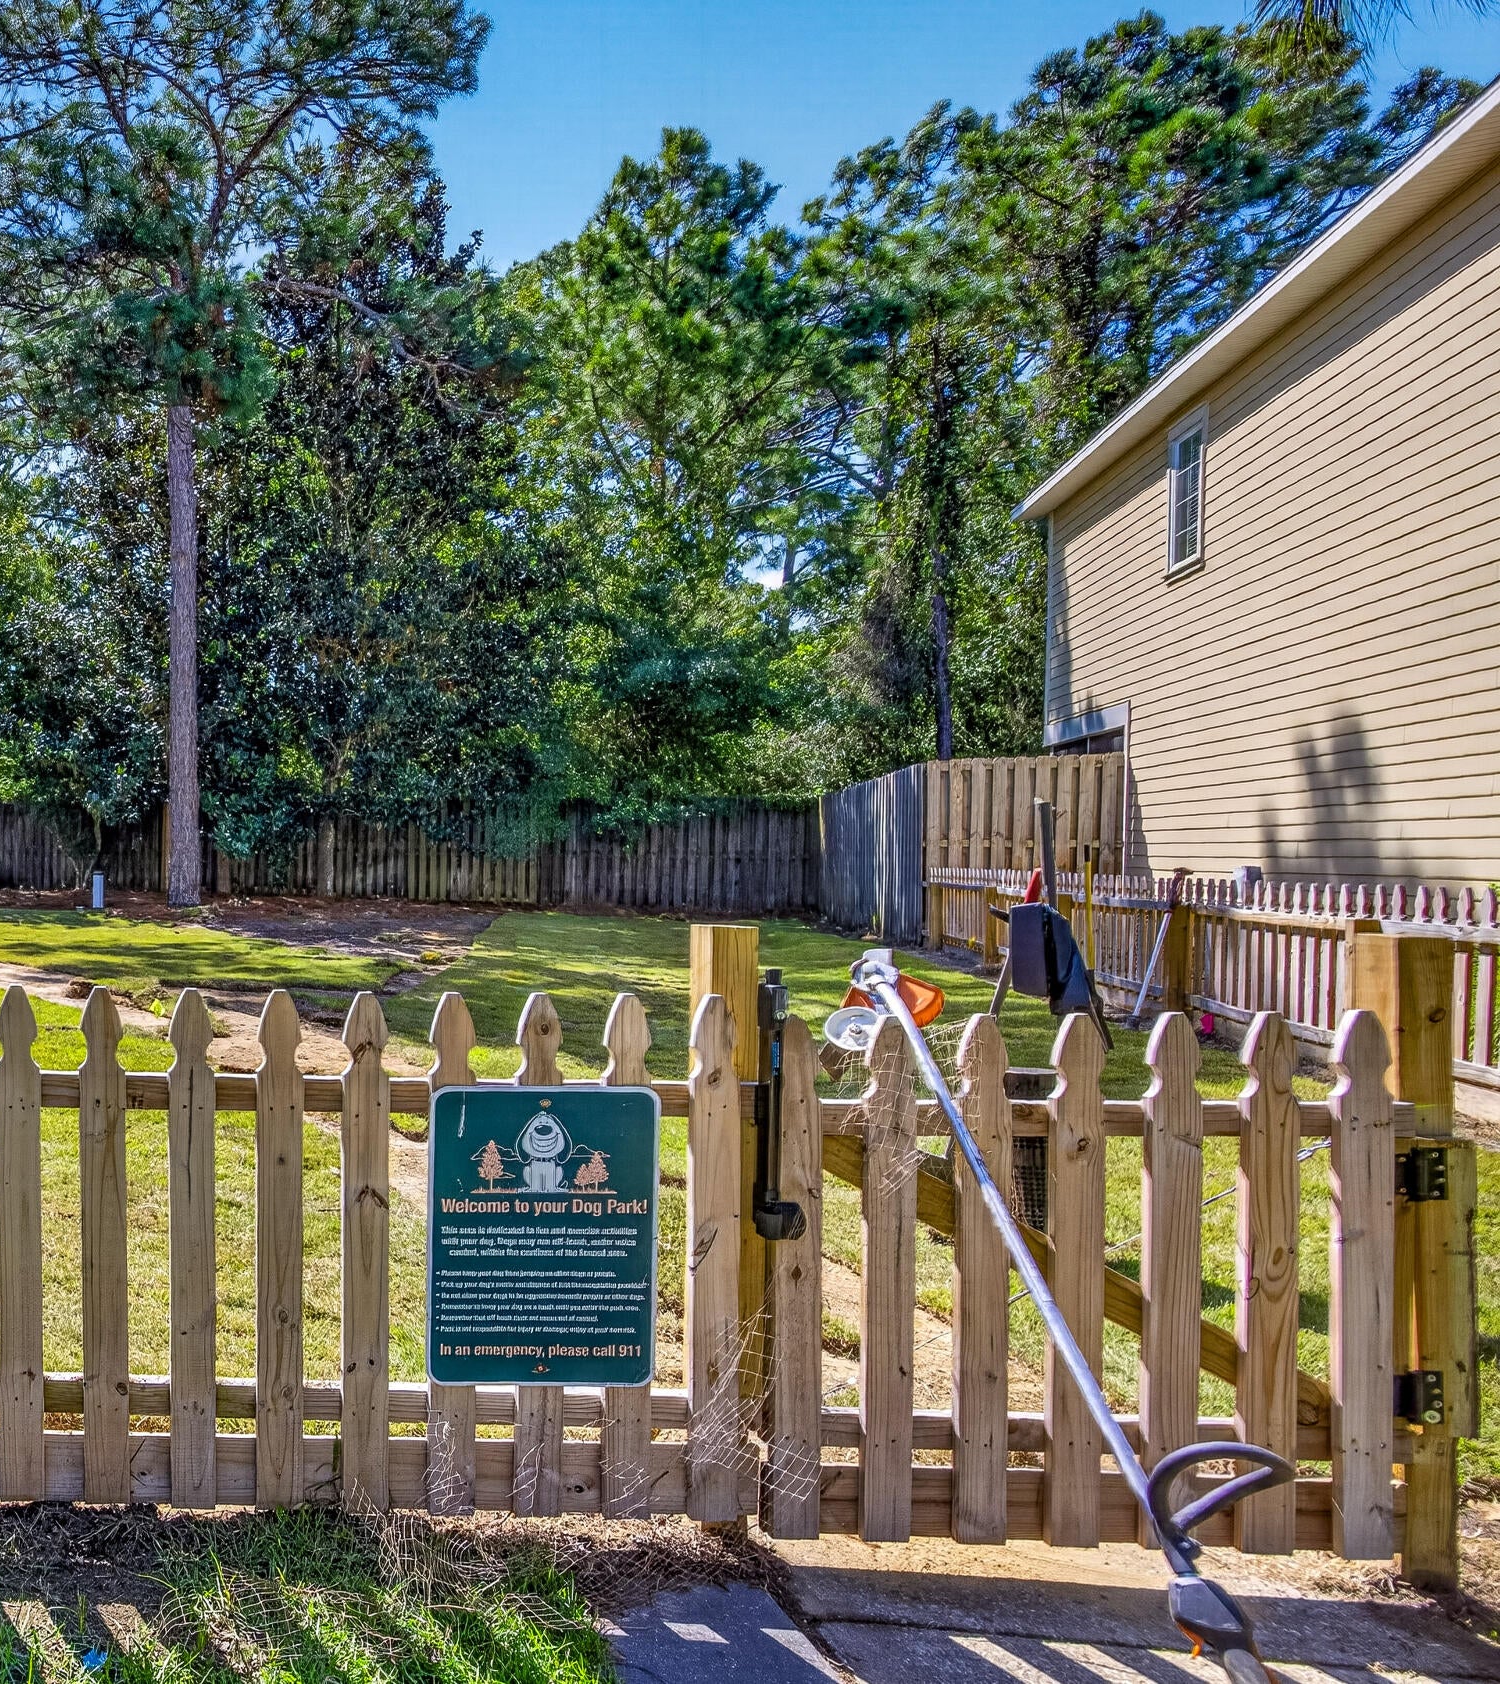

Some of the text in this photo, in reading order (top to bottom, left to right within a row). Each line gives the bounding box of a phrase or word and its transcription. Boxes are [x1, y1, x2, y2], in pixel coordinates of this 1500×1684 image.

[441, 1198, 648, 1216] Welcome to your Dog Park!
[440, 1343, 641, 1359] In an emergency, please call 911
